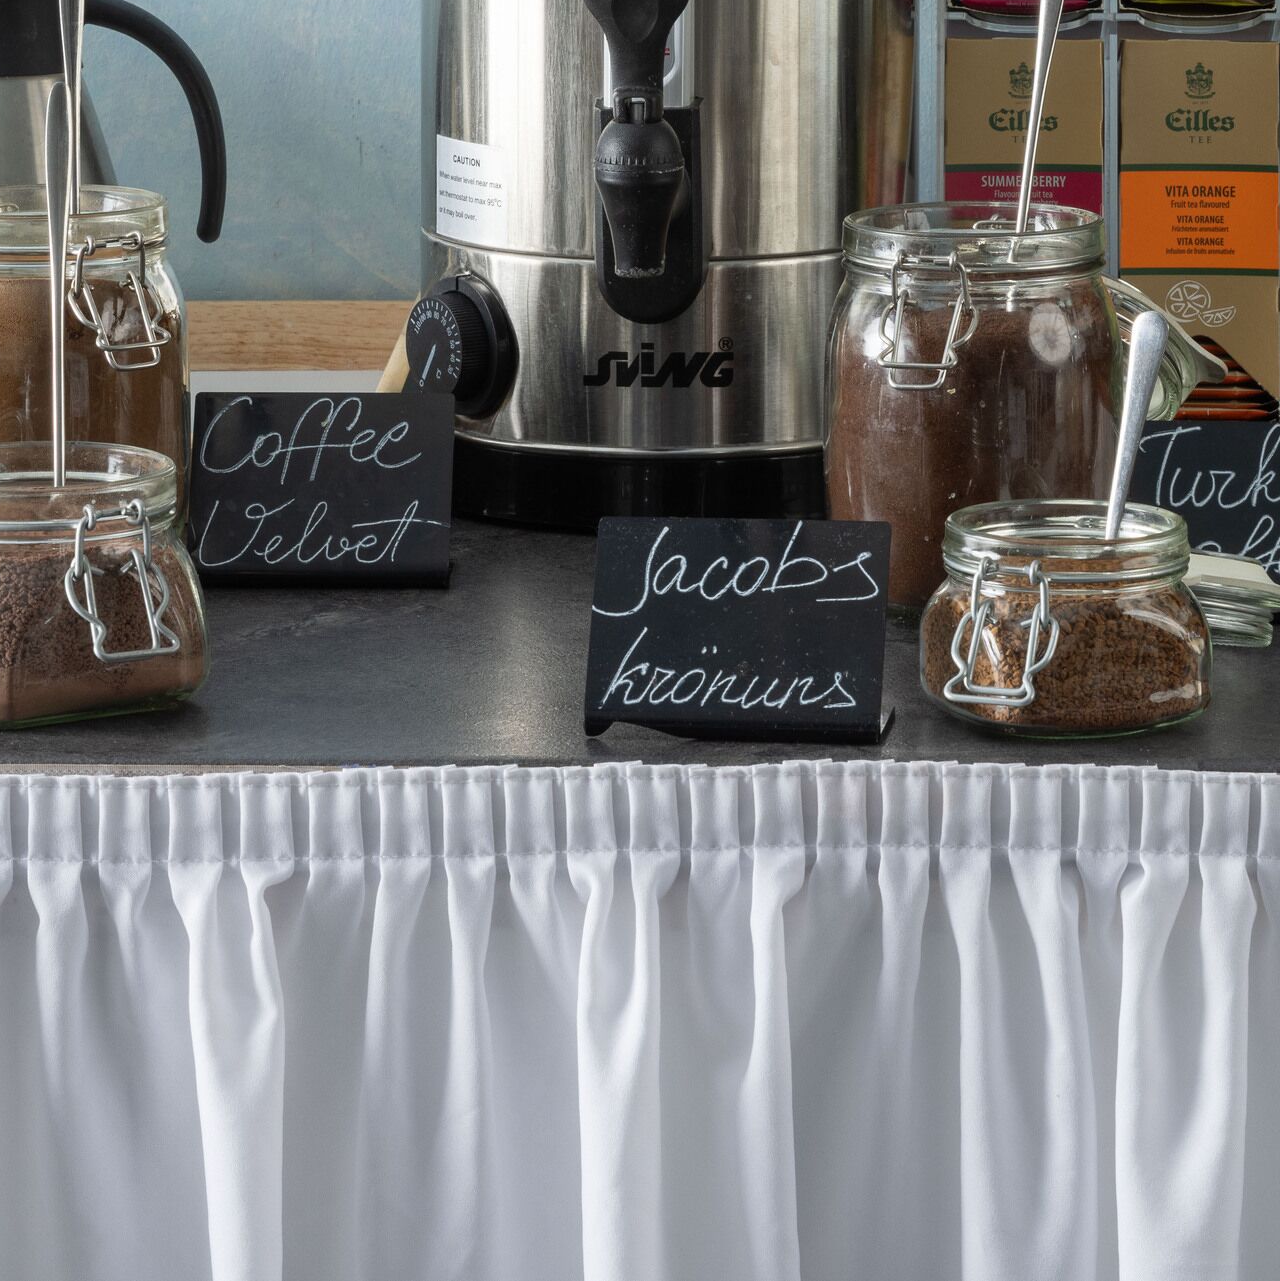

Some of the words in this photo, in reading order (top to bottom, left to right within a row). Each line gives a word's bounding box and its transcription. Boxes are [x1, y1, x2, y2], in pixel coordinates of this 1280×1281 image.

[988, 108, 1059, 132] Eills
[1165, 108, 1236, 132] Eilles
[1188, 135, 1213, 144] TEE
[452, 154, 481, 168] CAUTION
[981, 175, 1067, 188] SUMMEBERRY
[1042, 191, 1054, 199] tea
[1165, 185, 1189, 198] VITA
[1191, 185, 1237, 198] ORANGE
[1170, 199, 1186, 209] Fruit
[1188, 200, 1198, 209] tea
[1199, 199, 1230, 209] flavoured
[1176, 215, 1193, 224] VITA
[1194, 215, 1225, 224] ORANGE
[1176, 237, 1193, 246] VITA
[1194, 237, 1225, 246] ORANGE
[199, 395, 423, 486] Coffee
[198, 498, 451, 567] Velvet
[591, 520, 880, 617] Jacobs
